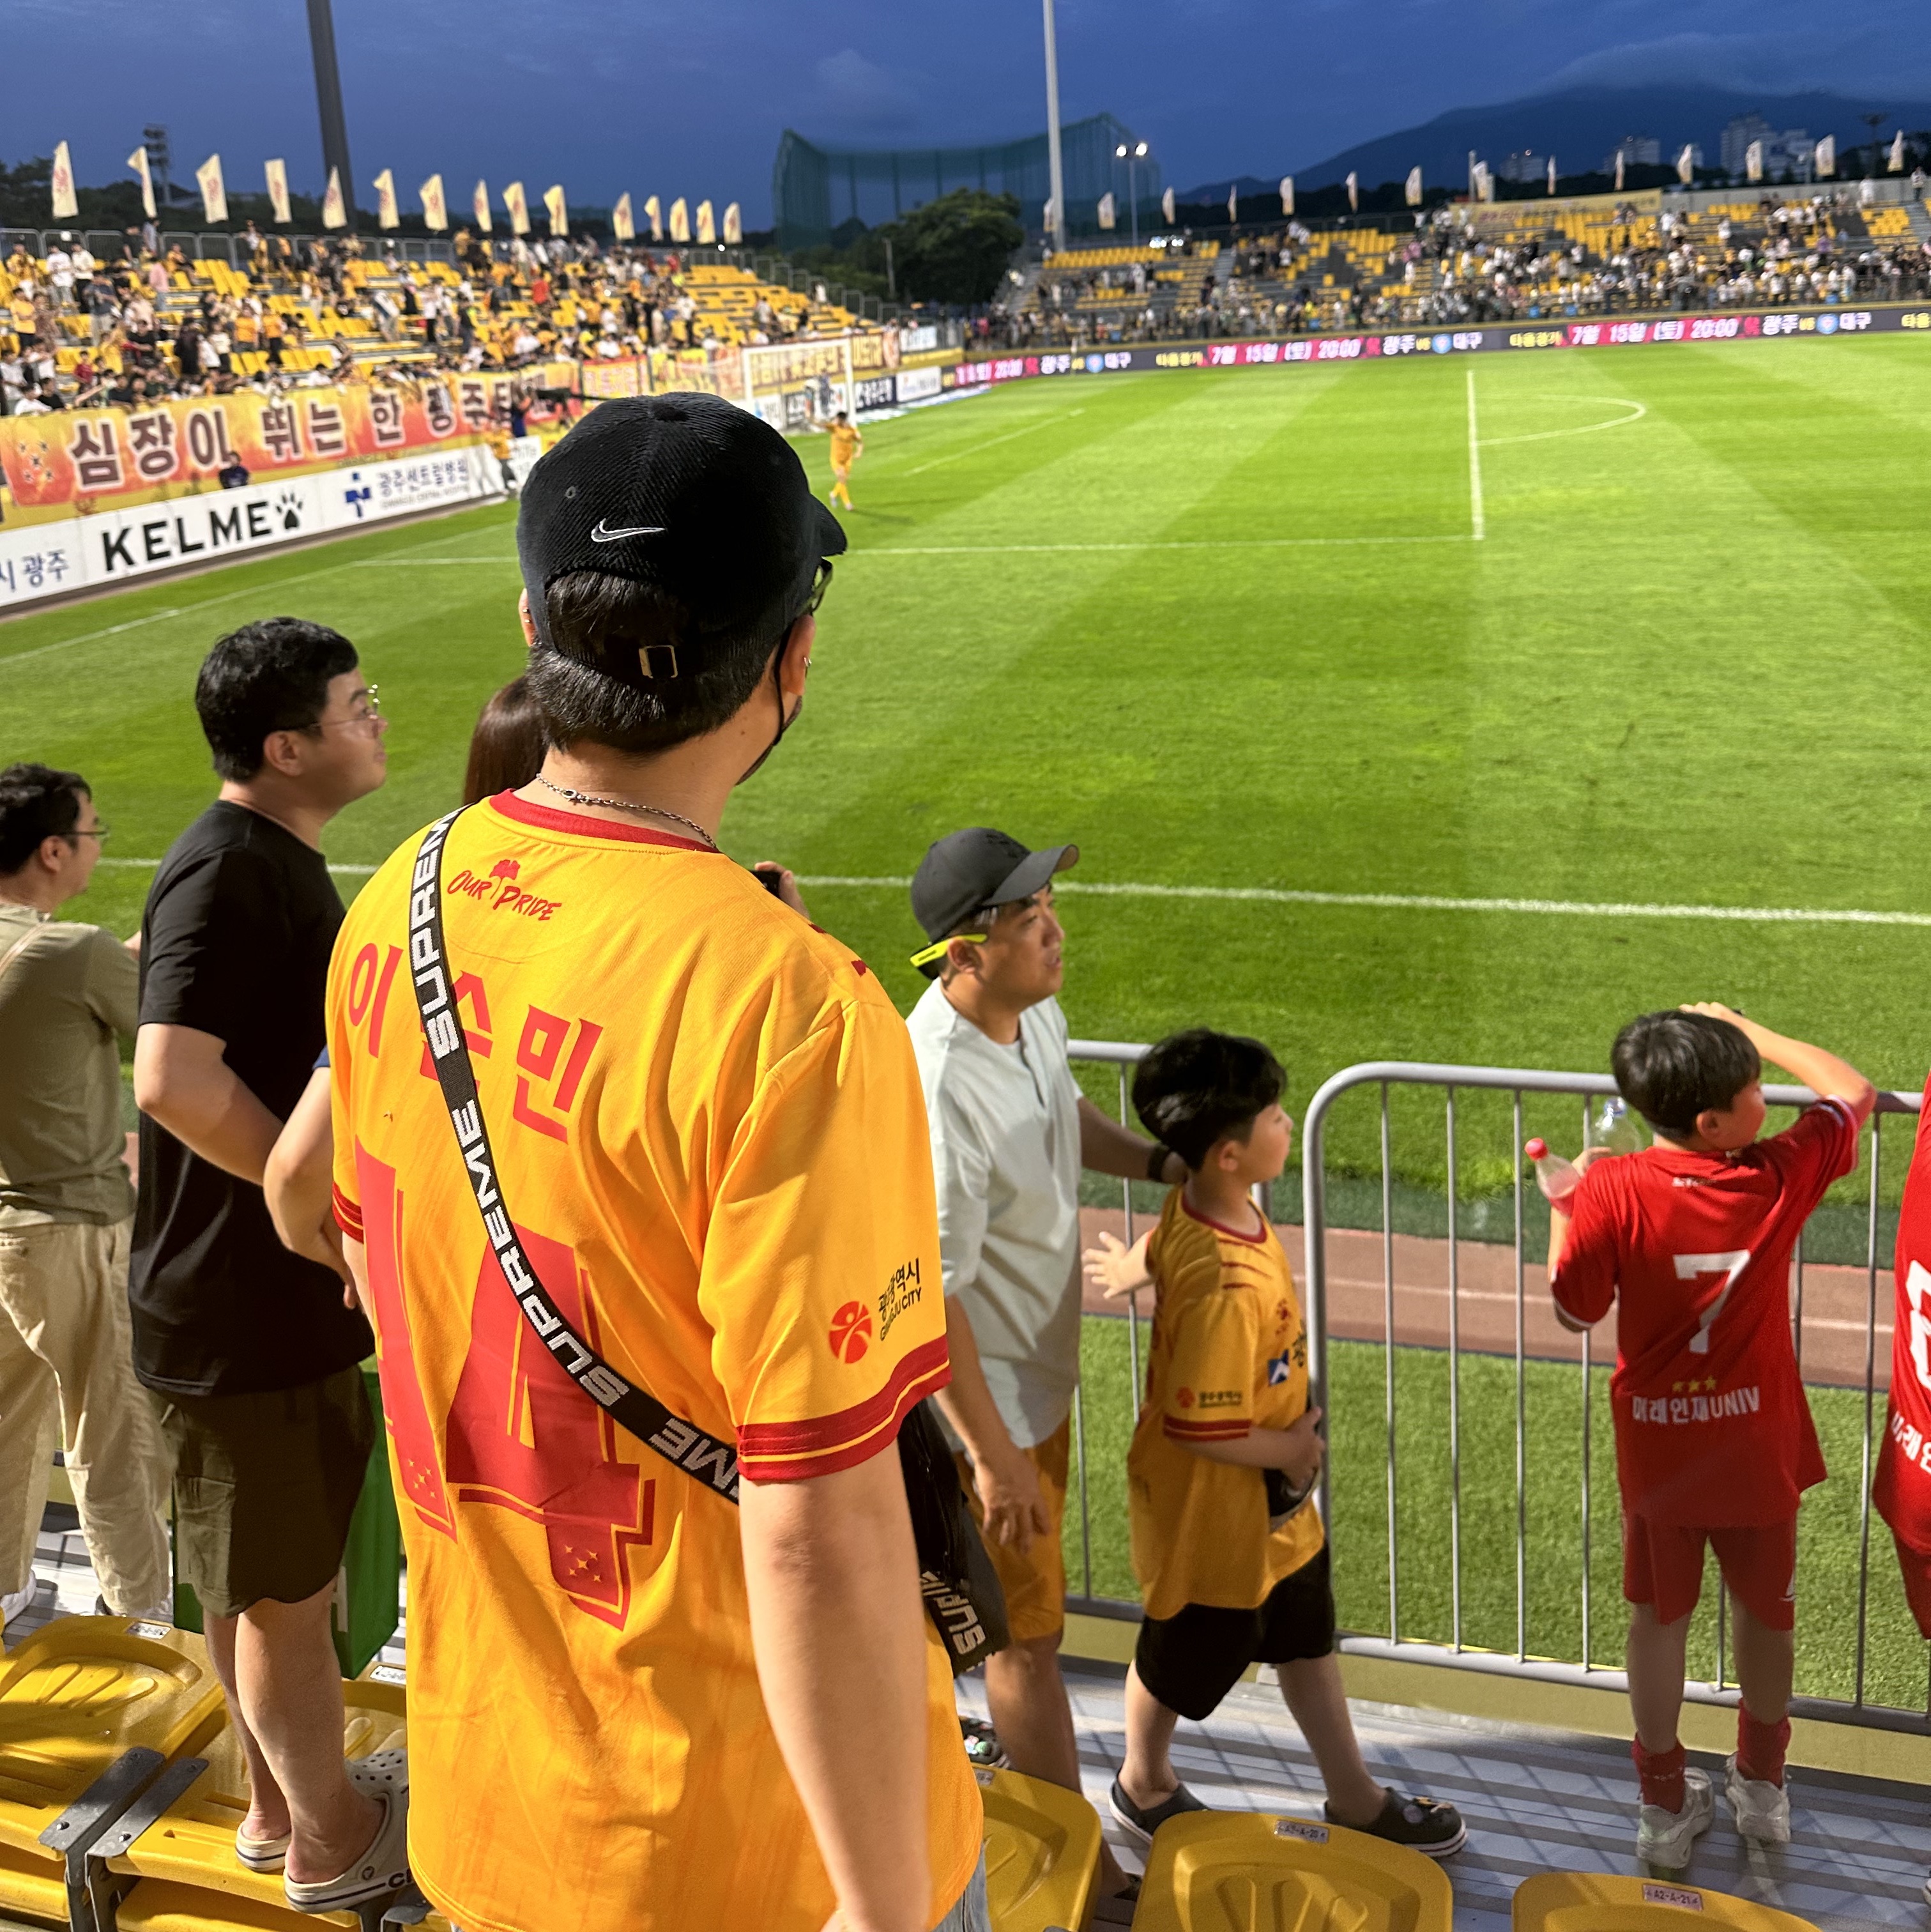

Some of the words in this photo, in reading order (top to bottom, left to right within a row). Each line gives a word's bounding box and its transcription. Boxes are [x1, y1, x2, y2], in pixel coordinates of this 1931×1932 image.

[1762, 314, 1800, 335] 광주
[1838, 312, 1872, 330] 대구
[69, 406, 233, 489] 심장이
[259, 400, 346, 460] 뛰는
[369, 390, 404, 446] 한
[22, 548, 68, 587] 광주
[102, 500, 272, 572] KELME
[451, 1100, 630, 1406] SUPREME
[902, 1286, 921, 1310] CITY
[1672, 1249, 1751, 1354] 7
